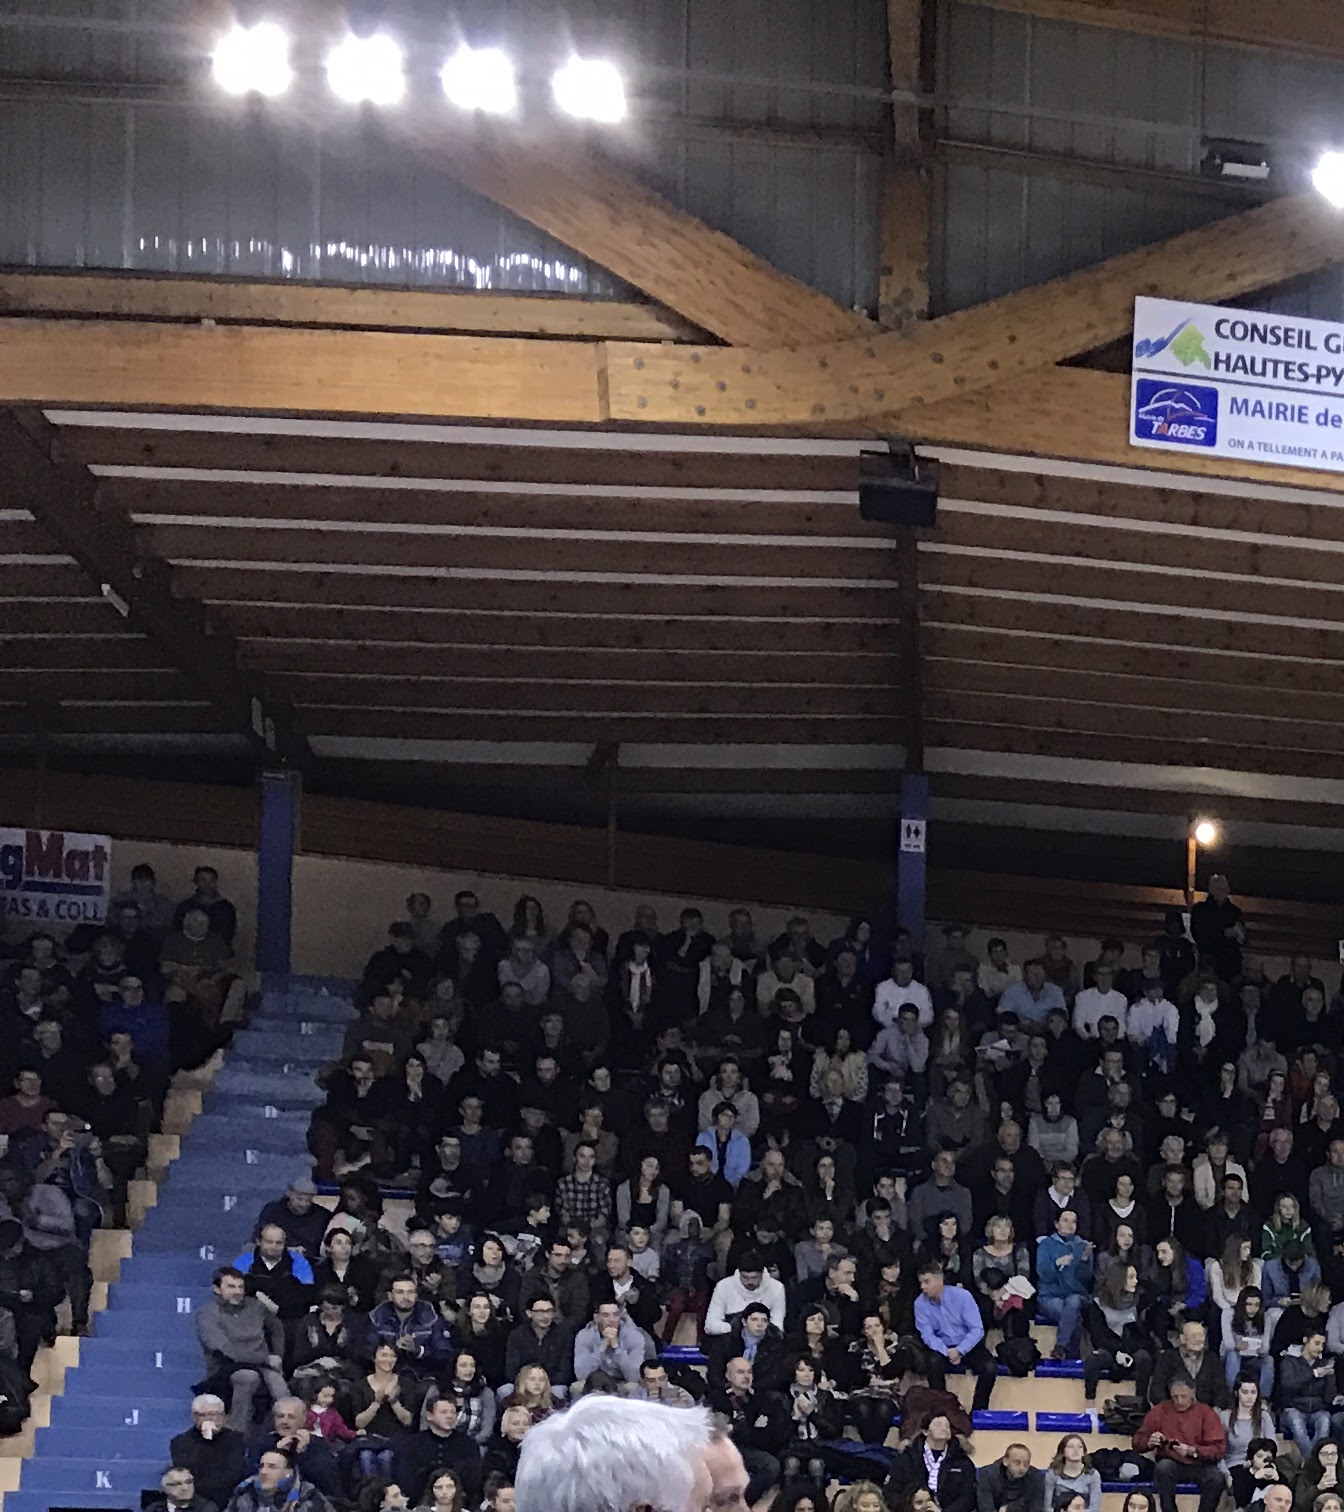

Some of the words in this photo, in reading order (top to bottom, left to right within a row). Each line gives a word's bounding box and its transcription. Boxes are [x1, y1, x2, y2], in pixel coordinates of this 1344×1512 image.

[1214, 318, 1318, 352] CONSEIL
[1229, 396, 1309, 425] MAIRIE
[1316, 407, 1342, 429] de
[1150, 417, 1207, 442] TARBES
[1228, 438, 1244, 450] ON
[1256, 441, 1318, 459] TELLEMENT
[176, 1297, 191, 1314] H
[124, 1408, 140, 1426] J
[95, 1470, 113, 1489] K
